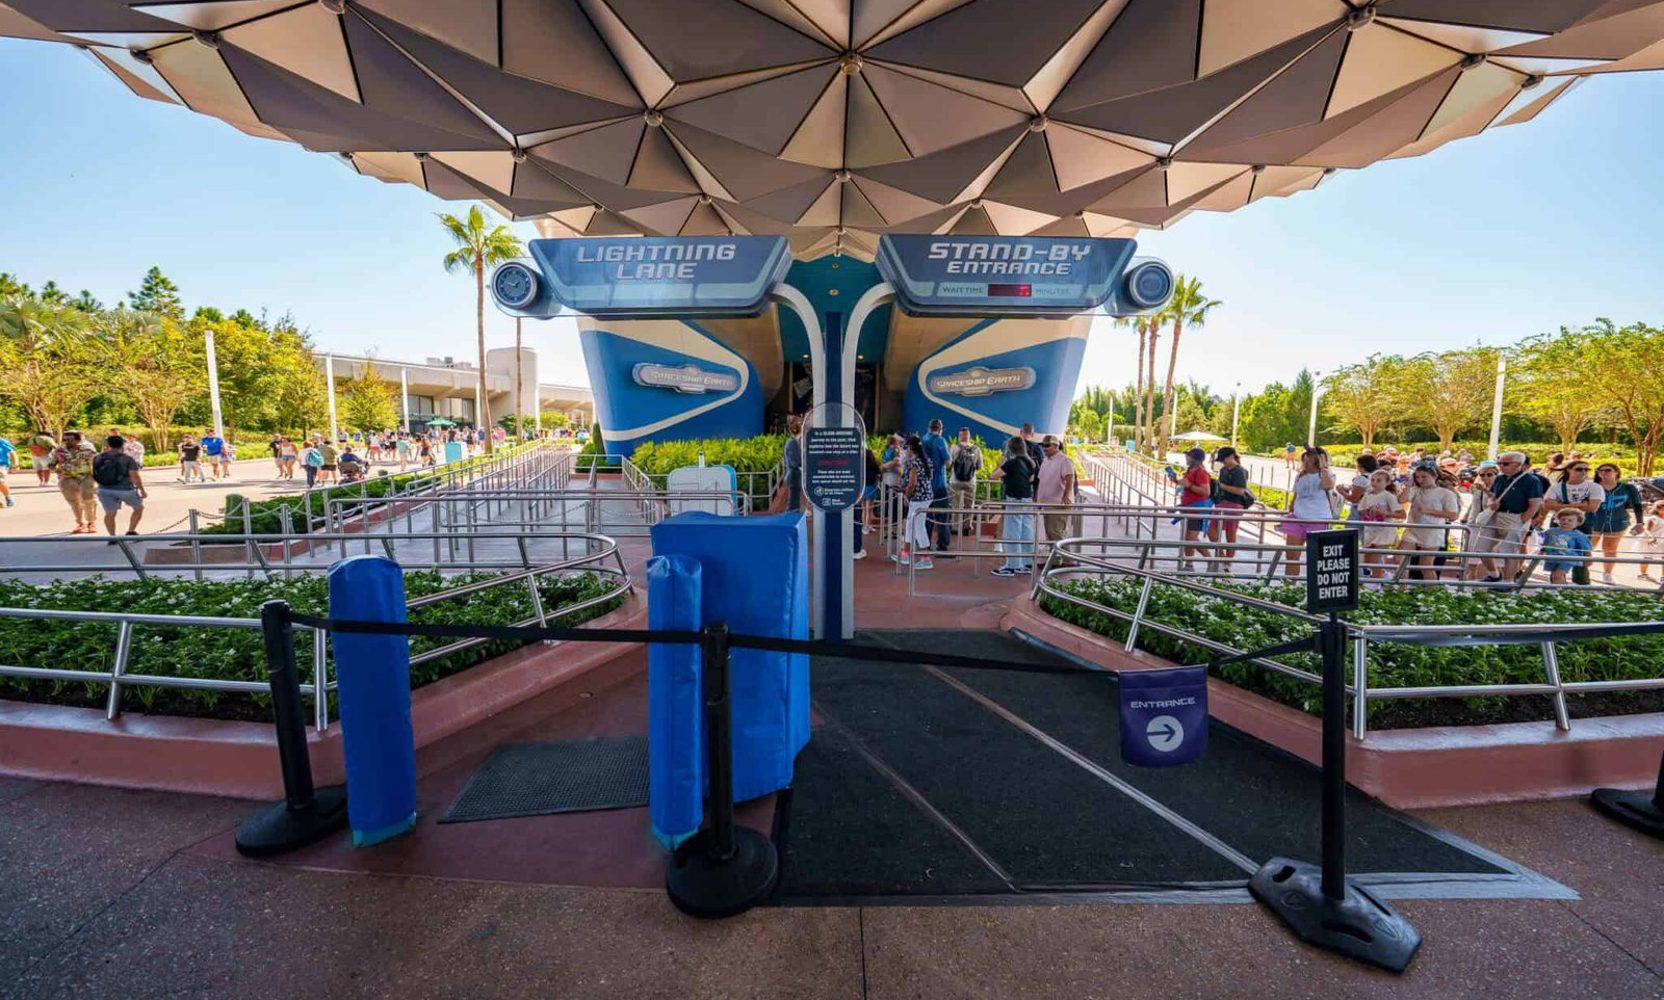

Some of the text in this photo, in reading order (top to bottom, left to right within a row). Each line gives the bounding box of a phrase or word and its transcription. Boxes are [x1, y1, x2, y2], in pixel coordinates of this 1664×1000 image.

[577, 243, 737, 262] LIGHTNING
[927, 242, 1092, 261] STAND-BY
[616, 262, 698, 280] LANE
[946, 261, 1072, 275] ENTRANCE
[1322, 544, 1344, 558] EXIT
[1316, 557, 1350, 572] PLEASE
[1316, 572, 1350, 586] DO NOT
[1318, 585, 1349, 600] ENTER
[1130, 697, 1197, 709] ENTRANCE
